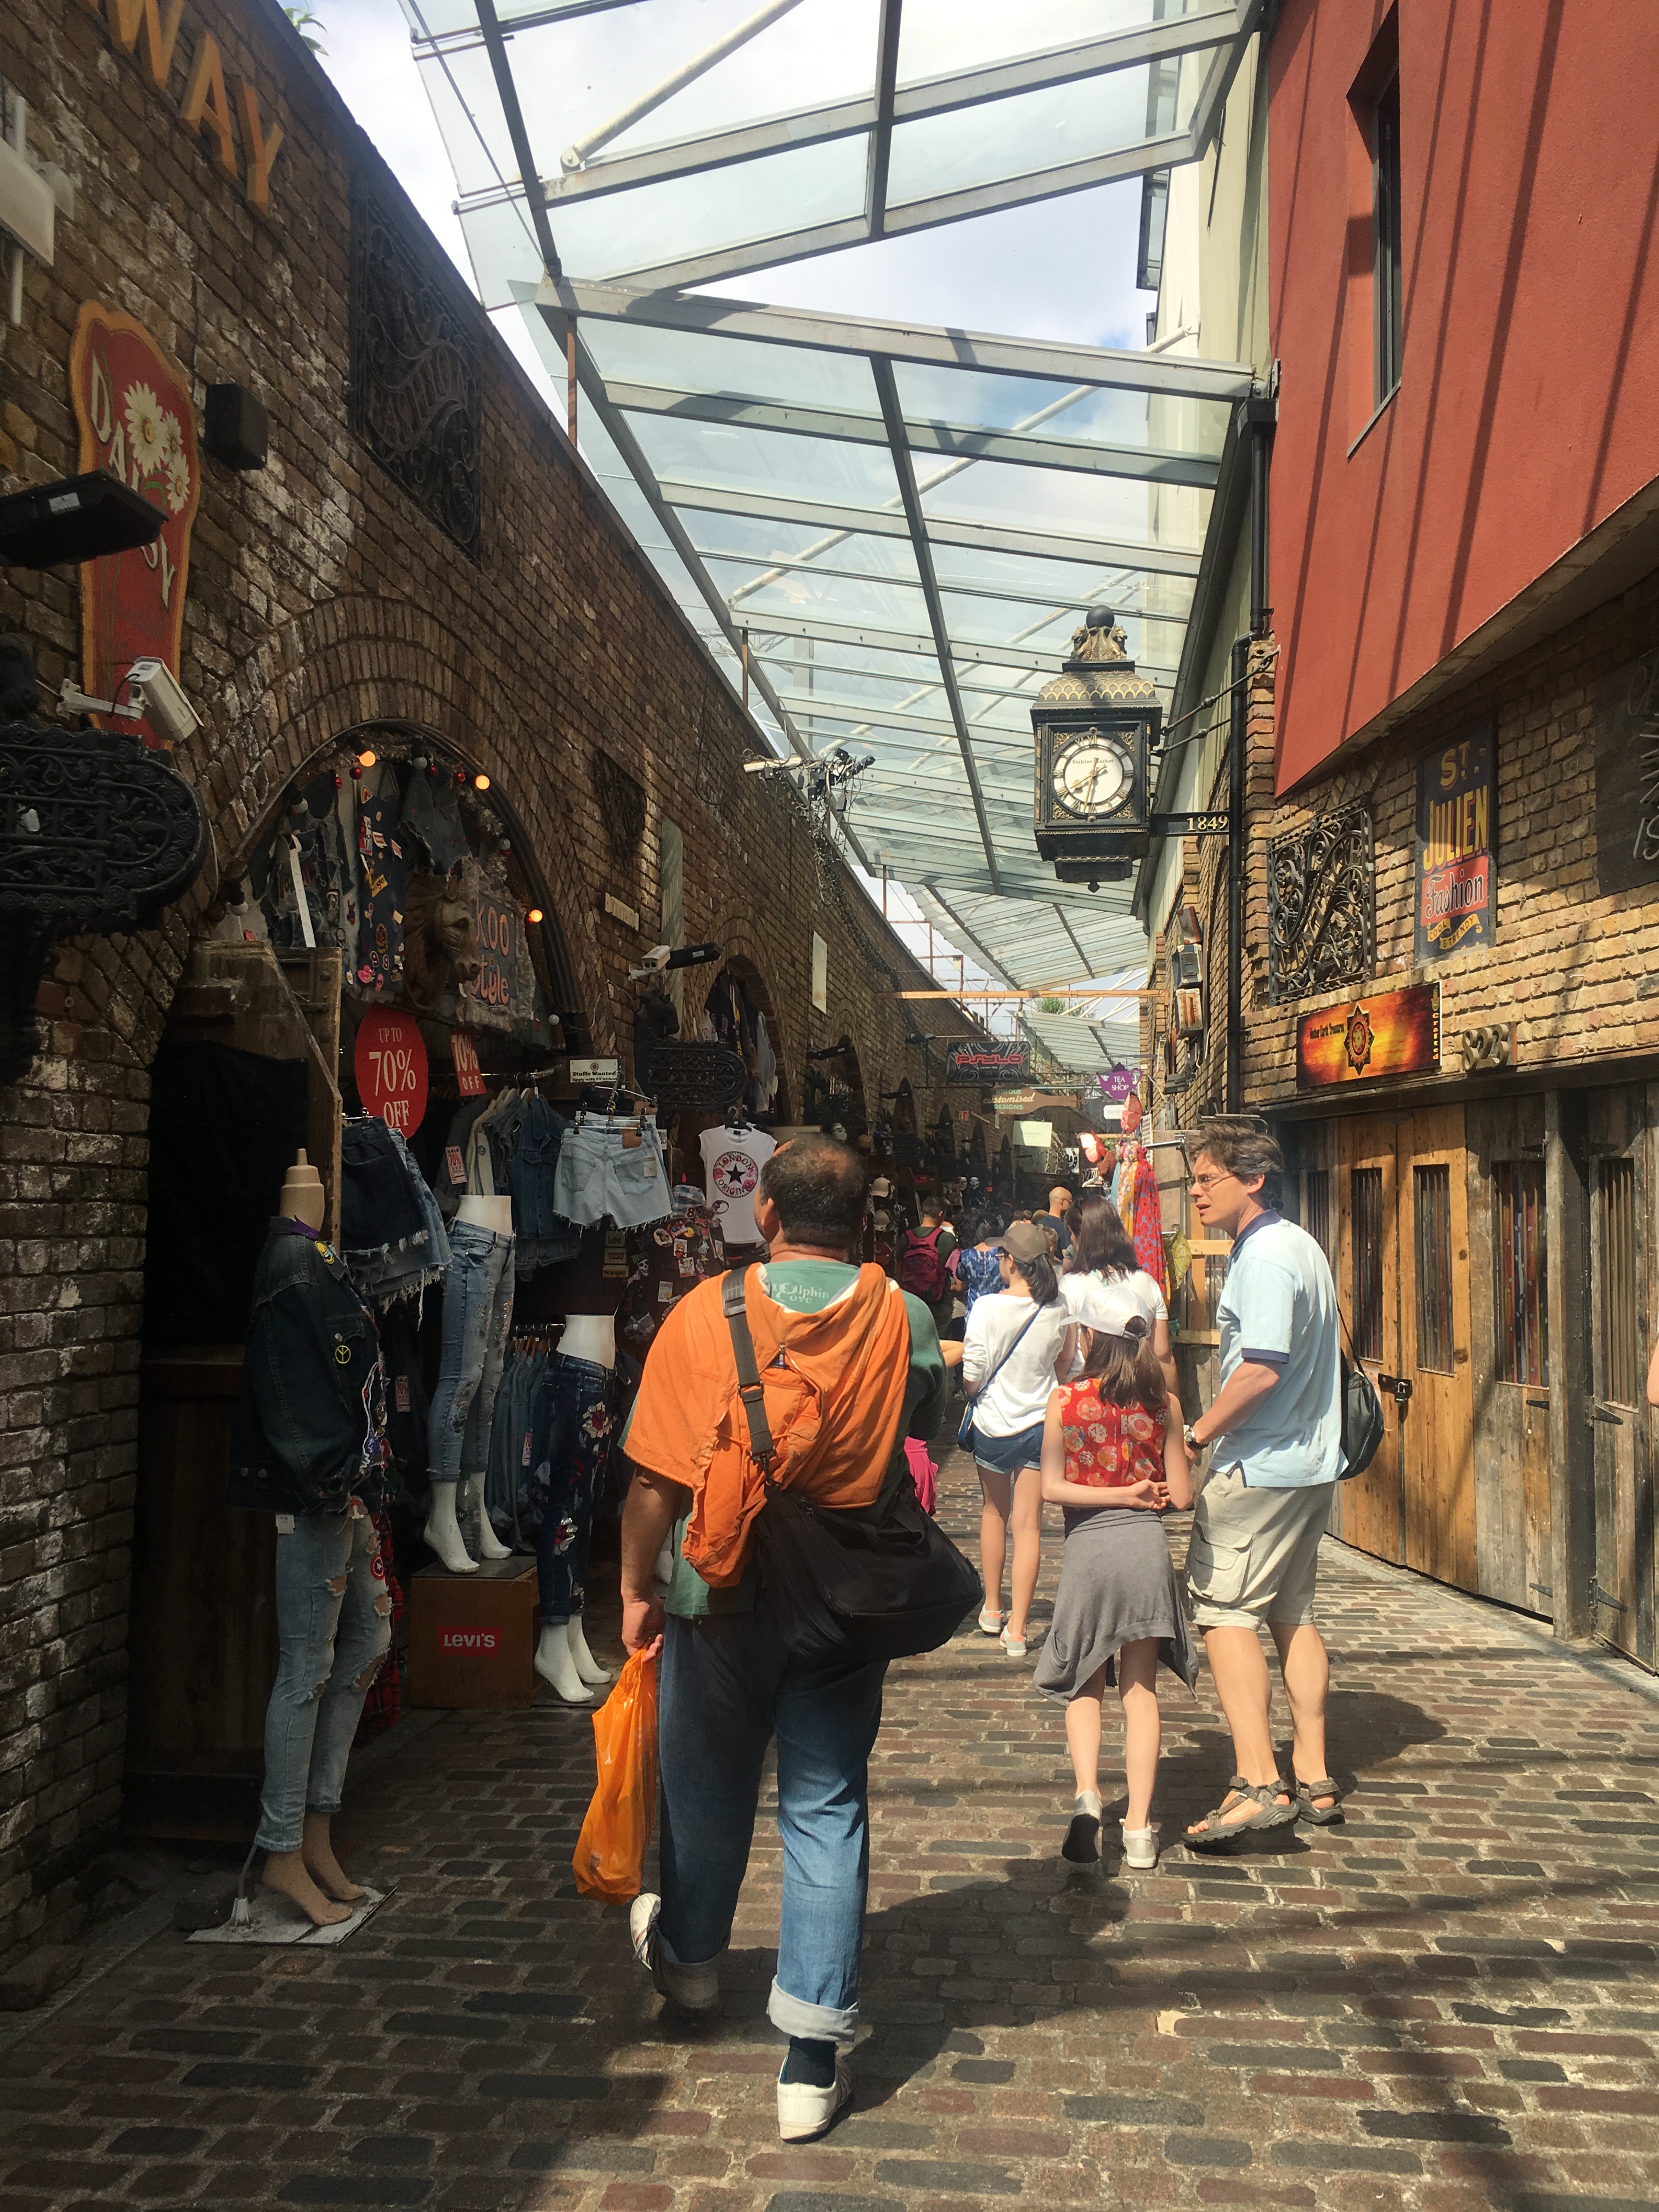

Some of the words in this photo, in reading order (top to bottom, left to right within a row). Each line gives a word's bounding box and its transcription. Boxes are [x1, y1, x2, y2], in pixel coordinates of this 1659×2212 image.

[1187, 815, 1228, 831] 1849
[1423, 784, 1488, 874] JULIEN
[1425, 870, 1484, 919] Fashion
[1429, 922, 1447, 941] COOL
[1448, 916, 1475, 945] TRENDY
[379, 1028, 390, 1042] UP
[392, 1027, 402, 1042] TO
[1462, 1024, 1509, 1071] 823
[369, 1048, 416, 1096] 70%
[462, 1075, 479, 1090] OFF
[983, 1092, 1036, 1104] customised
[383, 1100, 409, 1128] OFF
[718, 1154, 754, 1171] LONDON
[718, 1180, 753, 1195] ORIGINAL
